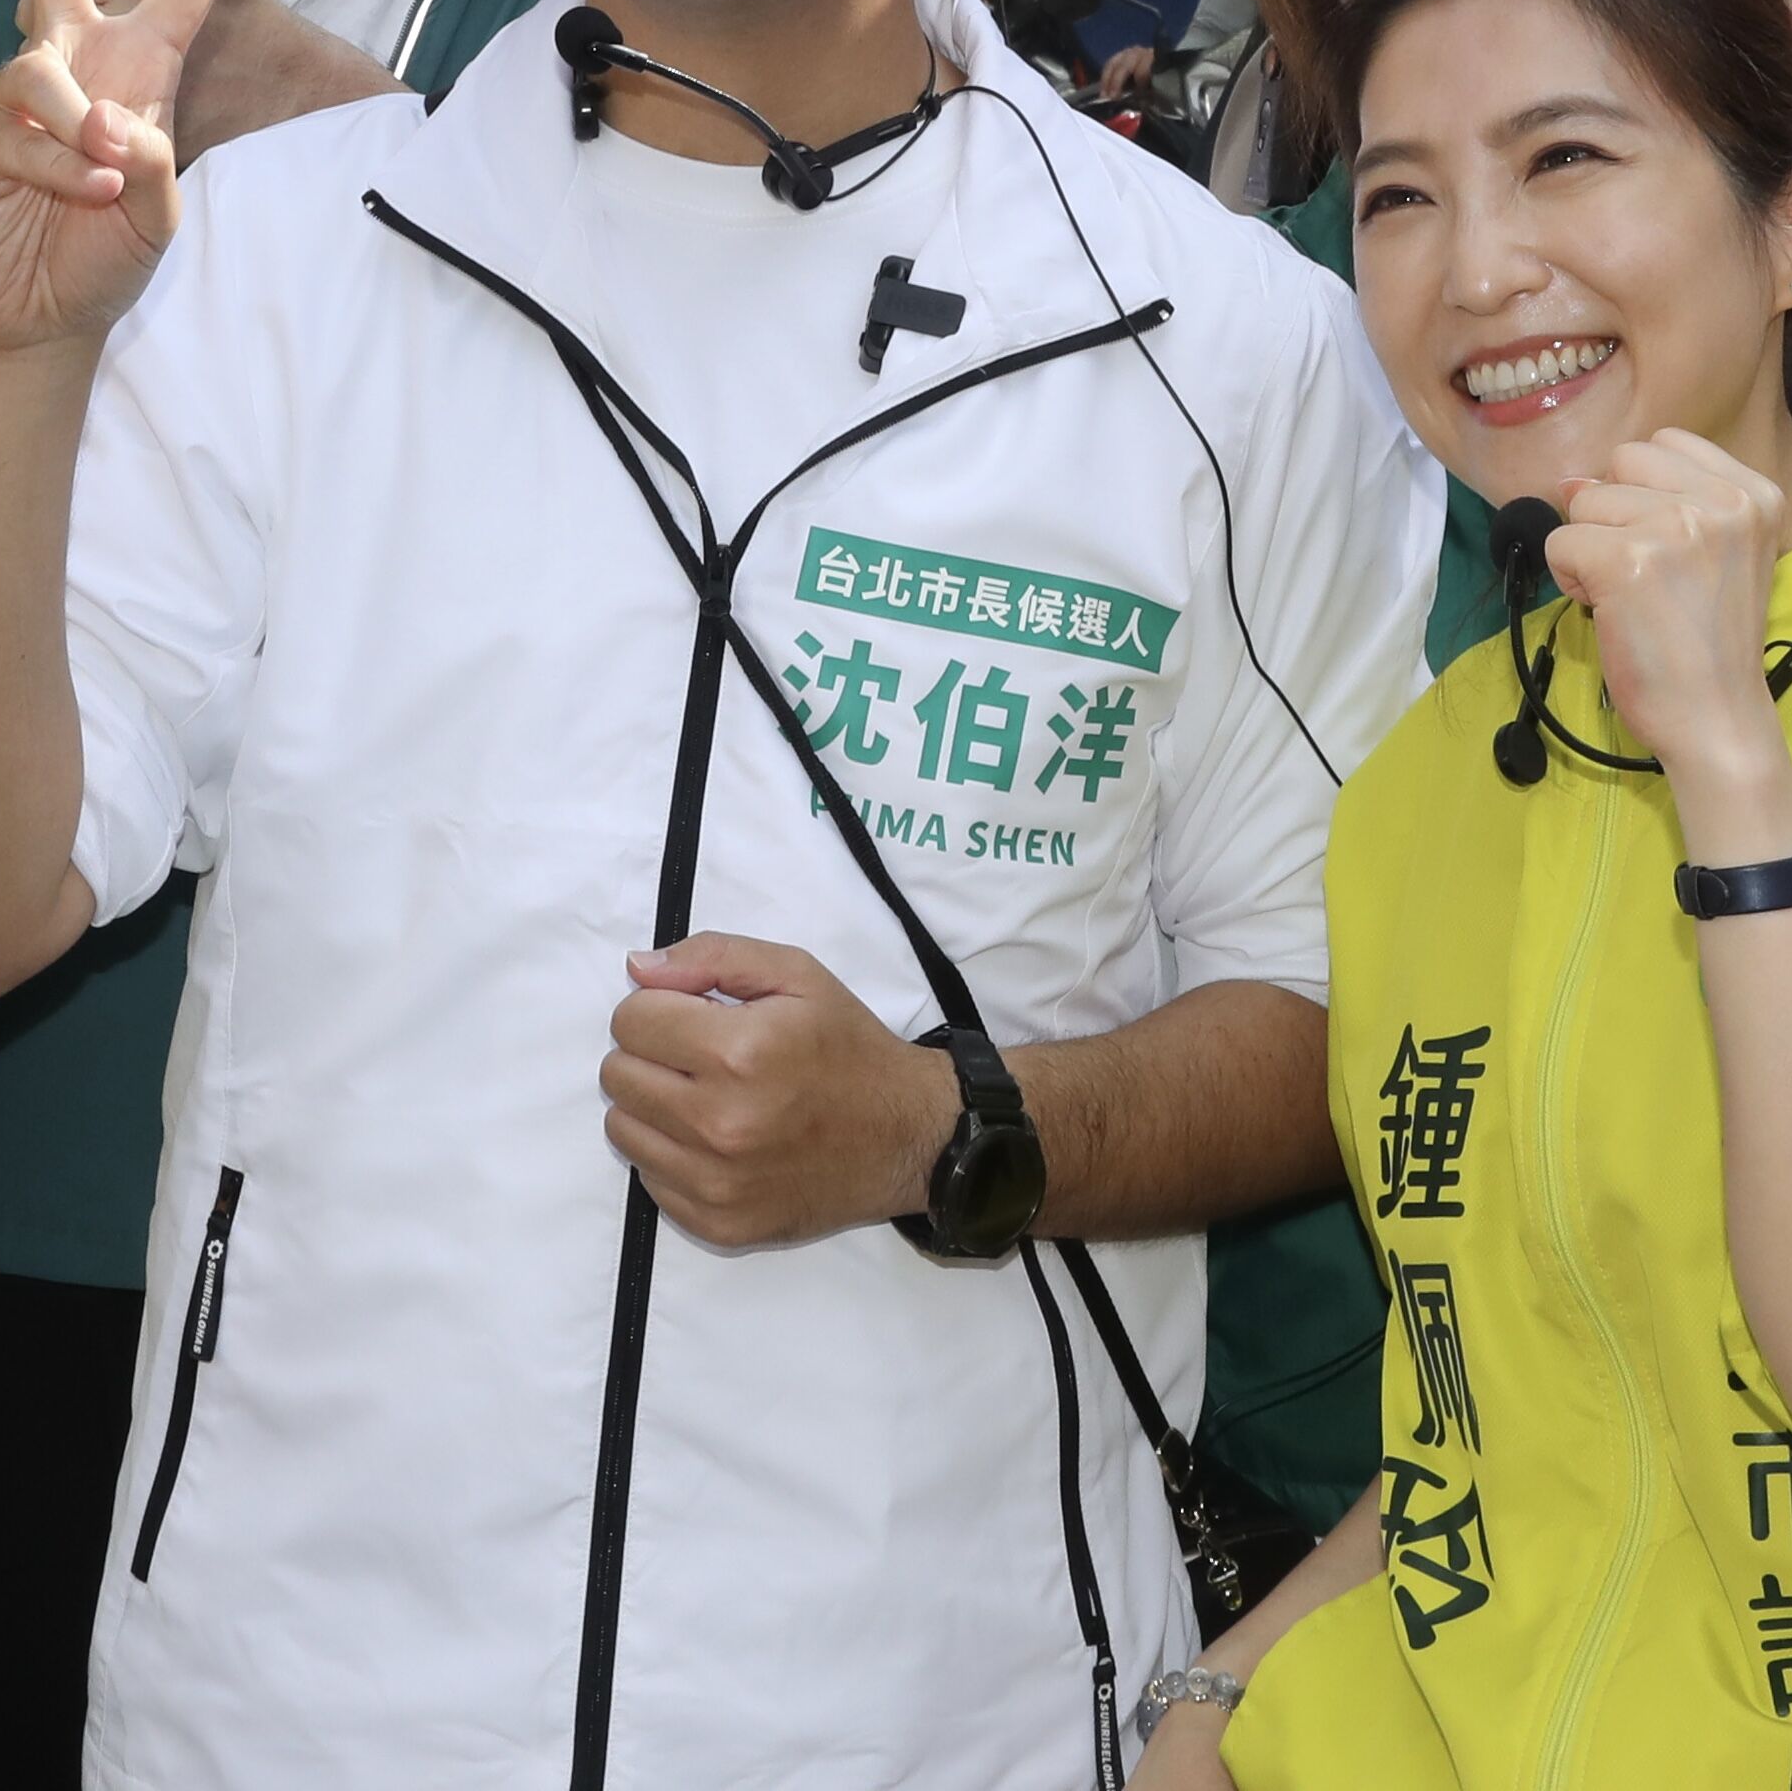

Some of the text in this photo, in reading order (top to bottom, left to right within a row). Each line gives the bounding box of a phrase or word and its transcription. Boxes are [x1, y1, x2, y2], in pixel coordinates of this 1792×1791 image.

[815, 544, 1153, 660] 台北市長候選人
[777, 629, 1138, 803] 沈伯洋
[964, 821, 1077, 867] SHEN
[192, 1259, 217, 1355] SUNRISELOHAS
